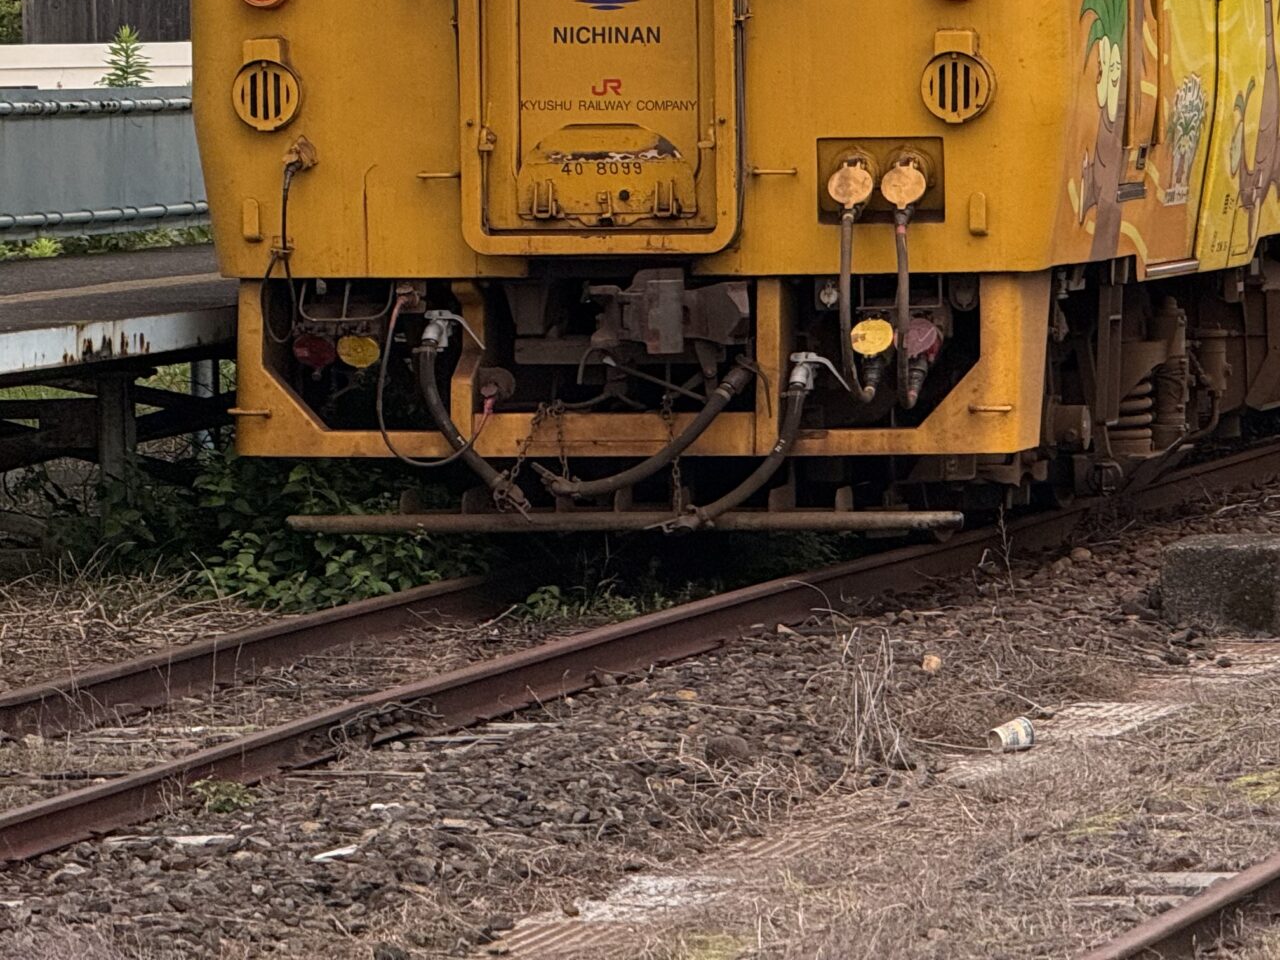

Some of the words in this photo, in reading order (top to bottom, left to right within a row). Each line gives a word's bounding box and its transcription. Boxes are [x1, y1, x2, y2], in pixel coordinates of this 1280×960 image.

[553, 26, 661, 45] NICHINAN
[591, 78, 622, 97] JR
[521, 100, 572, 111] KYUSHU
[578, 100, 632, 111] RAILWAY
[636, 100, 697, 111] COMPANY
[561, 162, 584, 176] 40
[596, 161, 643, 176] 8099
